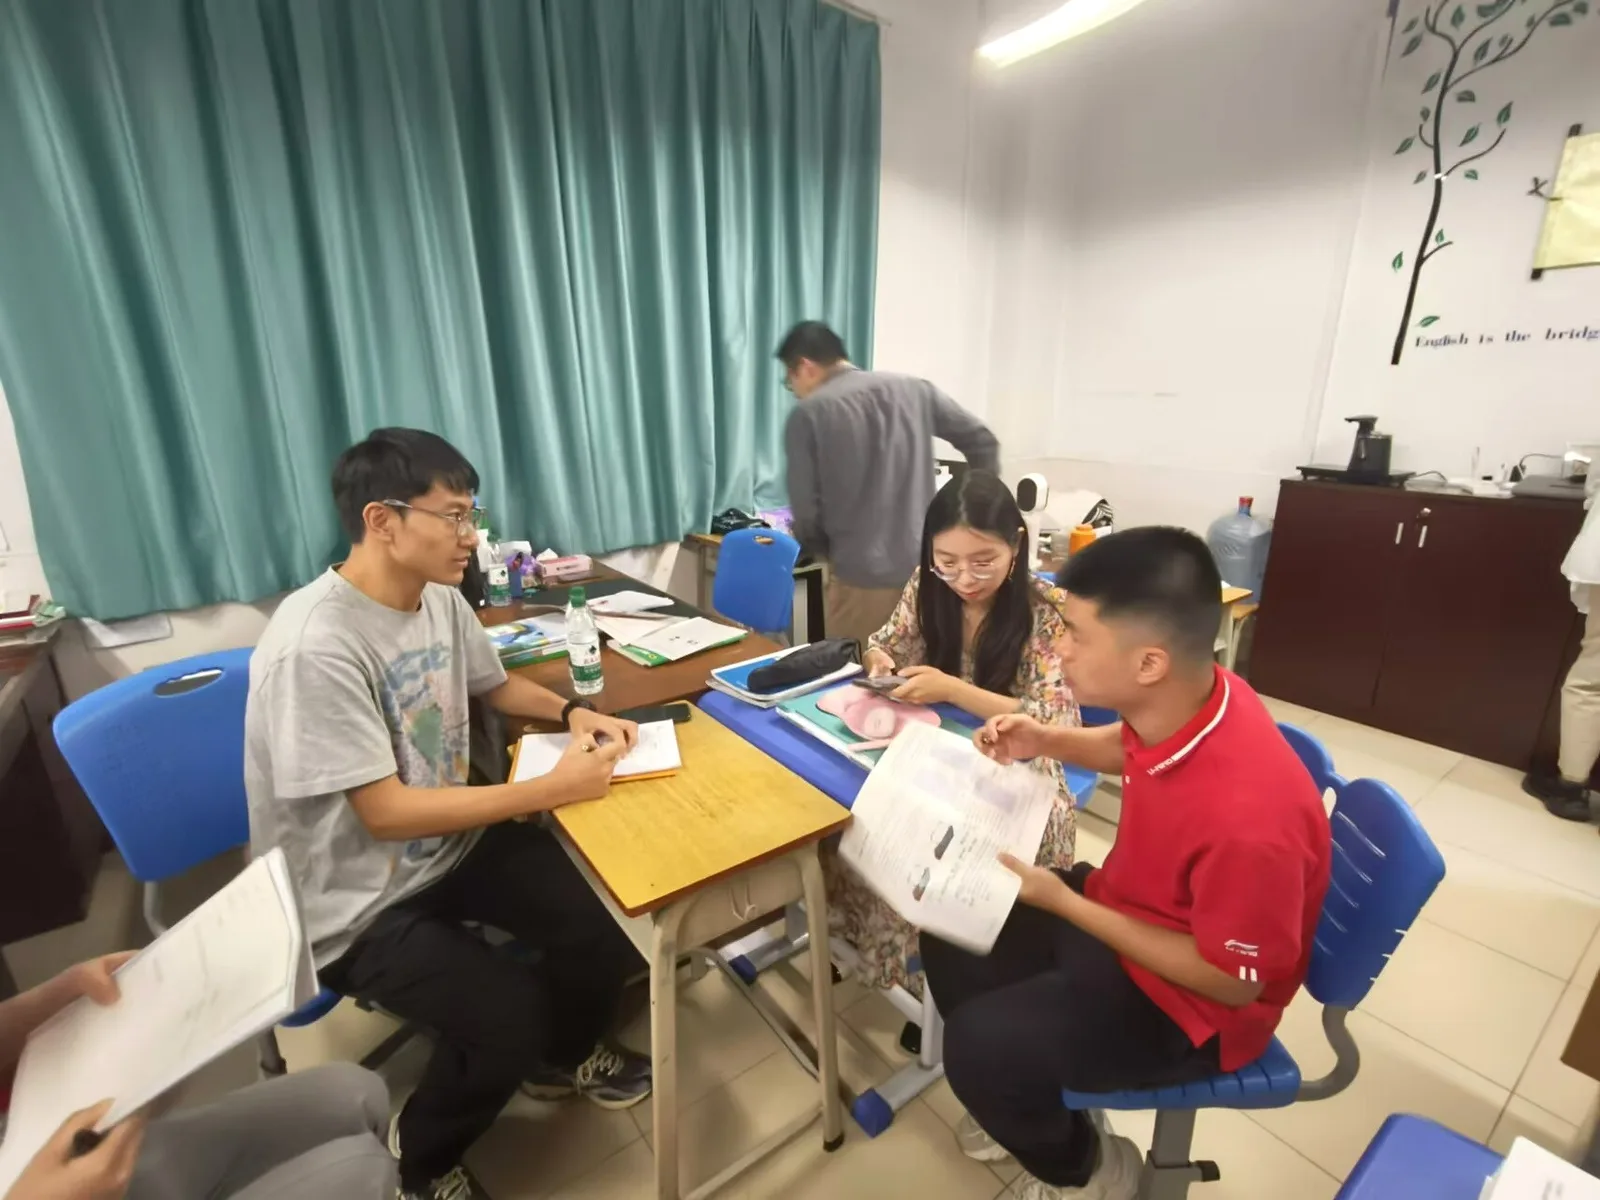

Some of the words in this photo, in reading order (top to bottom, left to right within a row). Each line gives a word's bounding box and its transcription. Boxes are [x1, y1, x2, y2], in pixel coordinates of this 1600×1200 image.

[1415, 332, 1468, 350] English
[1479, 334, 1494, 344] is
[1505, 330, 1531, 342] the
